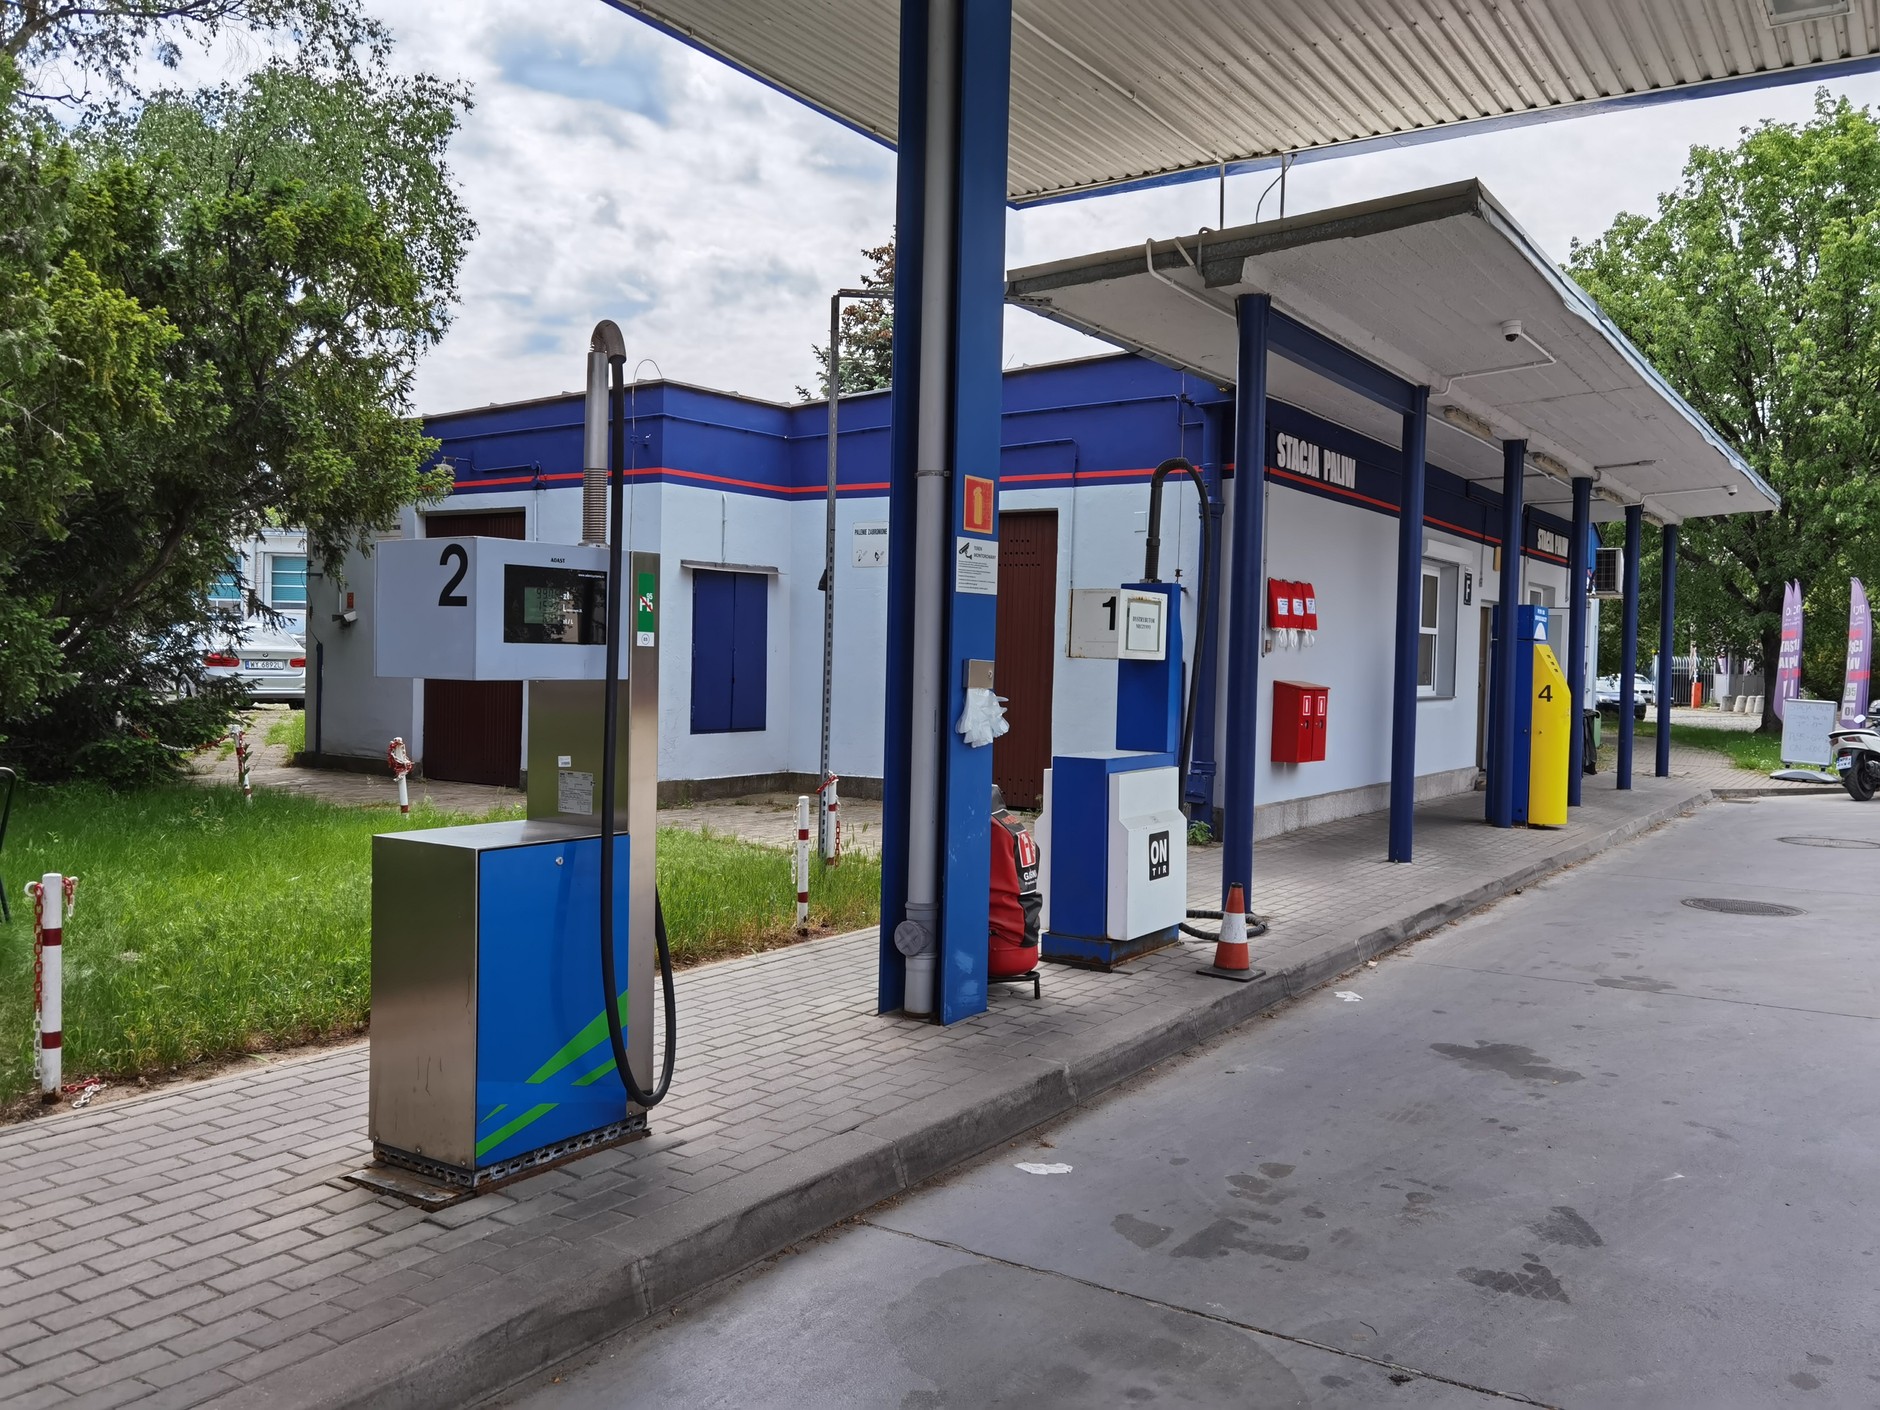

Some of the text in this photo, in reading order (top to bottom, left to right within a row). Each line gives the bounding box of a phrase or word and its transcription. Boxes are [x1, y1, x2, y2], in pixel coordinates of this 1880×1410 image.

[1276, 432, 1356, 489] STACJA PALIW
[1537, 528, 1569, 558] STACJA PALIW
[438, 543, 469, 607] 2
[1102, 596, 1117, 631] 1
[1538, 684, 1553, 703] 4
[1150, 838, 1167, 865] ON
[1152, 865, 1167, 876] TIR
